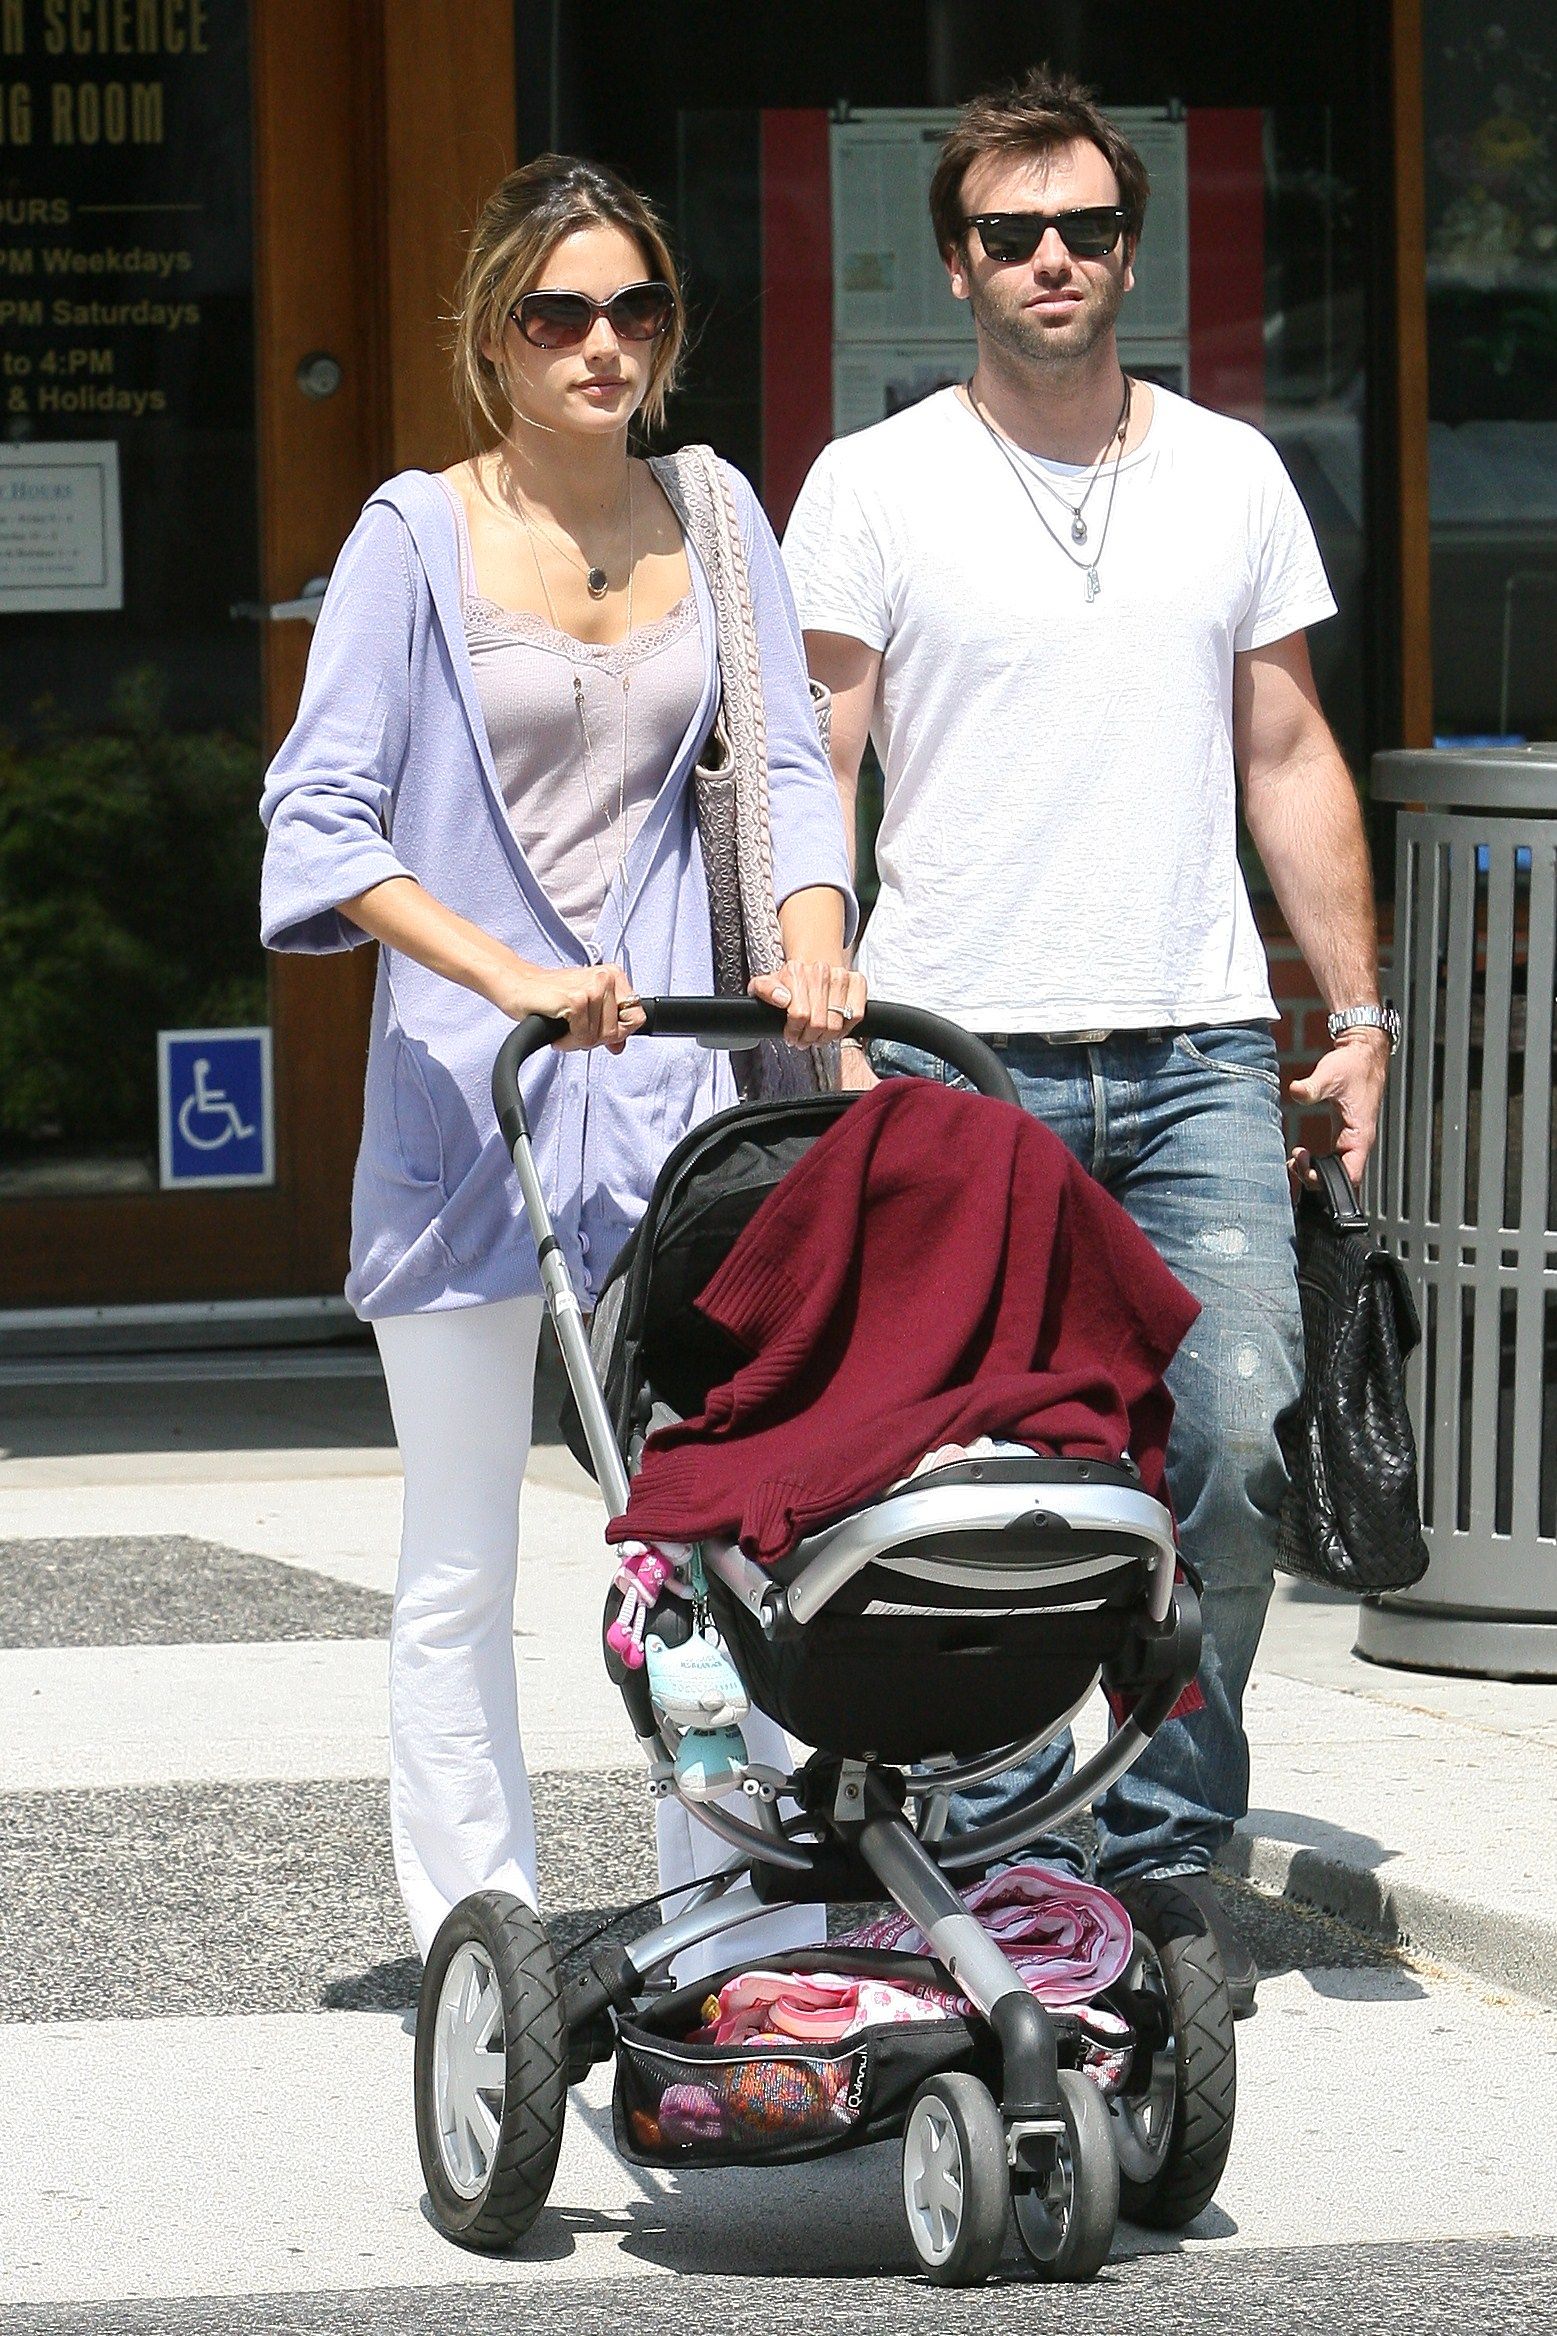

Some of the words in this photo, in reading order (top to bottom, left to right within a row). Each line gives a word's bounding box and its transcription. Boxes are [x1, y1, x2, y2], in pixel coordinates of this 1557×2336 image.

[44, 0, 208, 54] SCIENCE
[0, 81, 32, 145] G
[51, 81, 164, 145] ROOM
[42, 247, 193, 278] Weekdays
[0, 300, 43, 326] PM
[52, 299, 201, 332] Saturdays
[3, 350, 32, 376] to
[7, 385, 28, 412] &
[37, 385, 167, 417] Holidays
